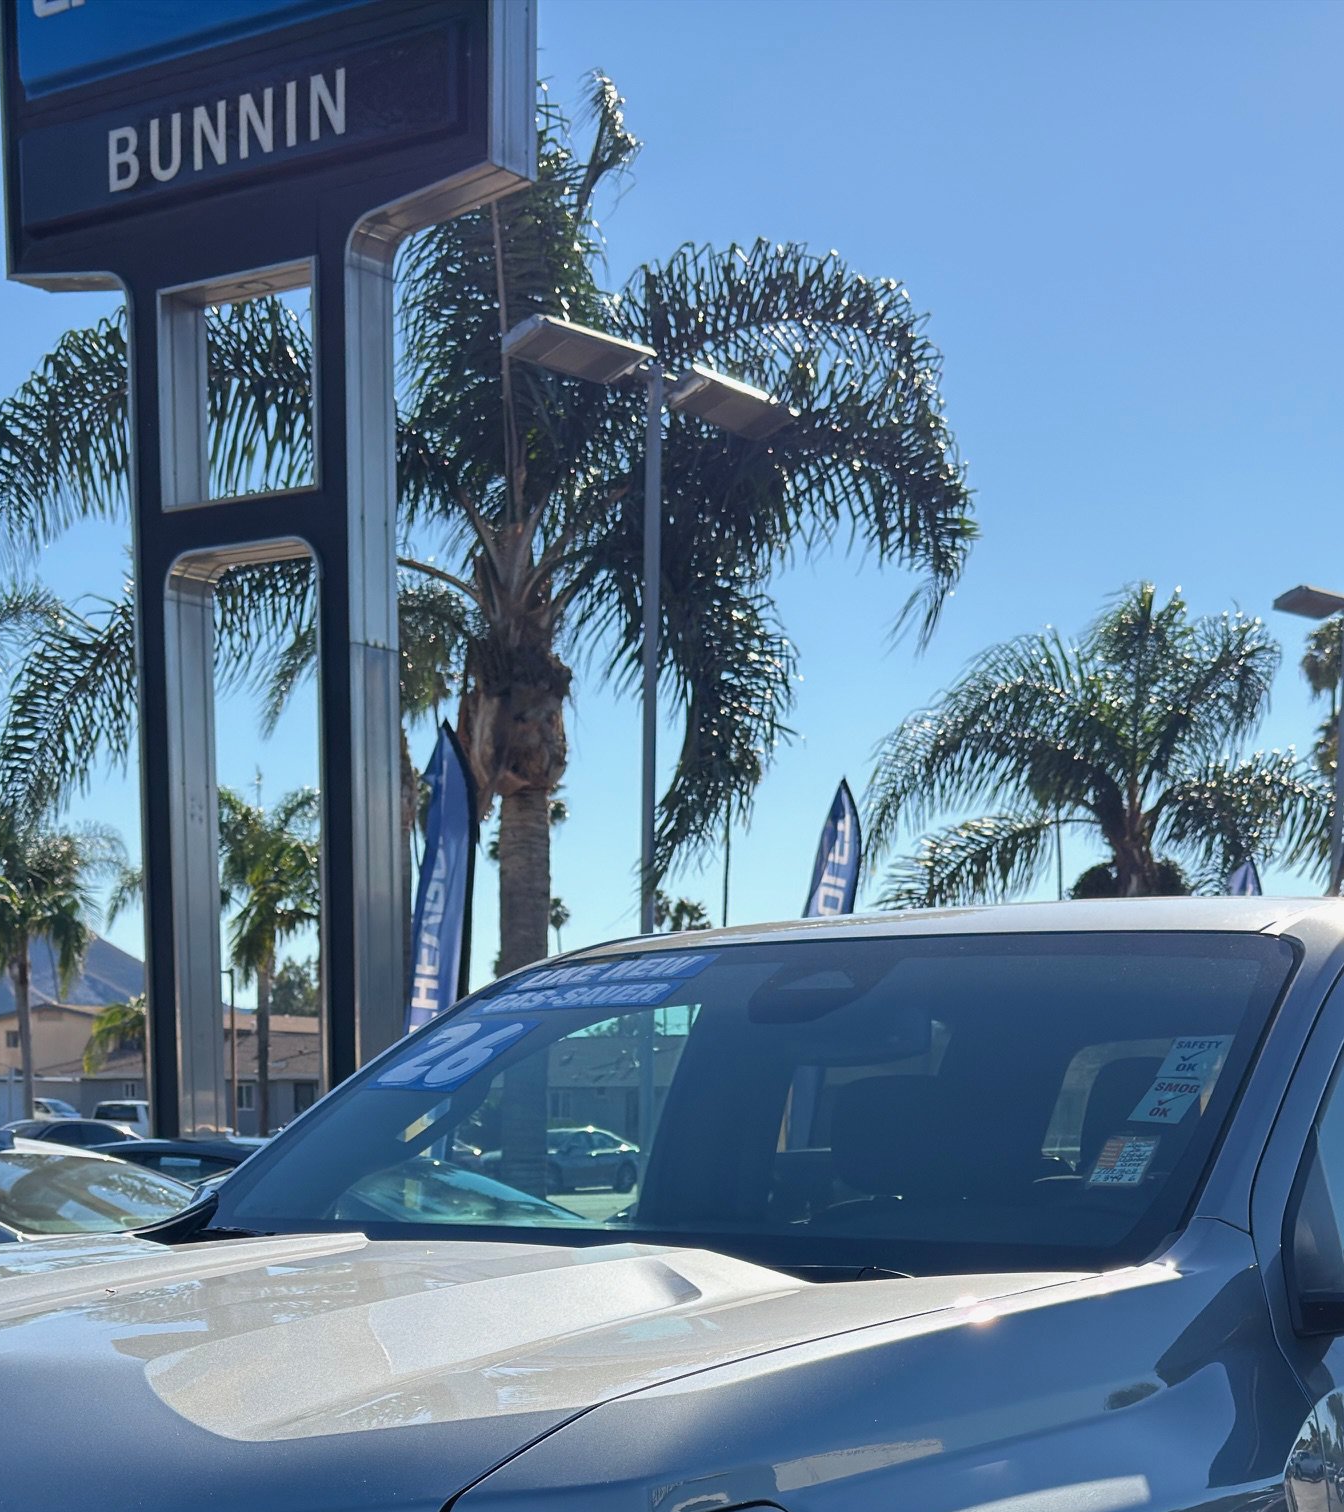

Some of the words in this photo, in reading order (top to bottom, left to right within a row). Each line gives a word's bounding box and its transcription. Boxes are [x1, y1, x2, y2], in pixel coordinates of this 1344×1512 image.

[108, 67, 346, 193] BUNNIN
[517, 963, 603, 990] LIKE
[602, 955, 705, 980] NEW
[1175, 1040, 1223, 1050] SAFETY
[376, 1022, 524, 1088] 26
[1175, 1063, 1199, 1073] OK
[1154, 1082, 1200, 1095] SMOG
[1148, 1107, 1172, 1118] OK
